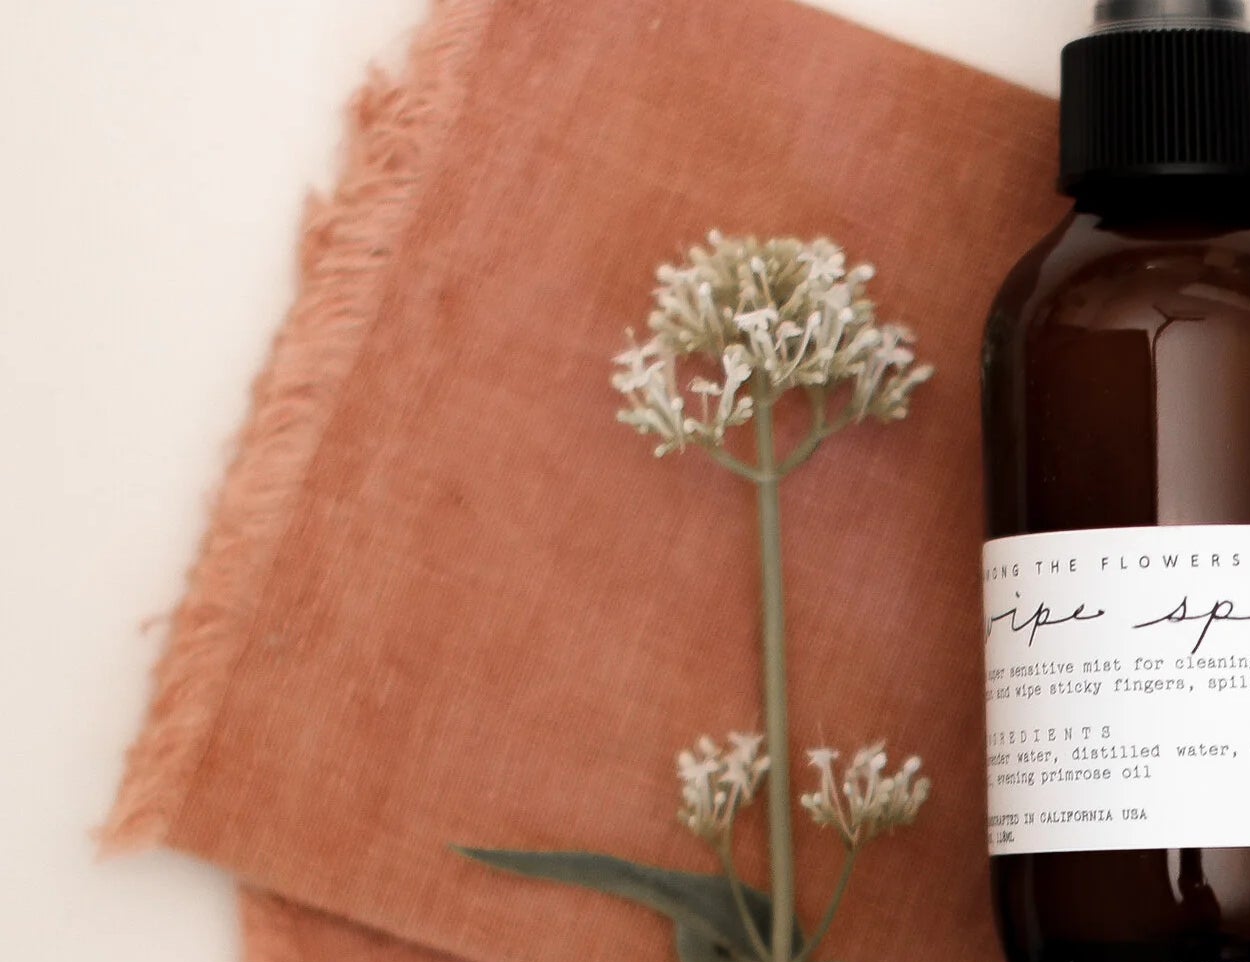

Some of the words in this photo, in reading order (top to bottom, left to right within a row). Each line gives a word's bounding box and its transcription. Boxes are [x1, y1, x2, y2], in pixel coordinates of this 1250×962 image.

[1035, 558, 1076, 574] THE
[1101, 553, 1240, 571] FLOWERS
[1009, 661, 1074, 678] sensitive
[1081, 657, 1122, 674] mist
[1133, 656, 1165, 672] for
[1015, 683, 1041, 699] wipe
[1049, 679, 1102, 695] sticky
[1114, 677, 1193, 694] fingers,
[1016, 748, 1059, 765] water,
[1071, 743, 1160, 760] distilled
[1175, 742, 1237, 759] water,
[1040, 767, 1111, 785] primrose
[1120, 763, 1152, 780] oil
[1038, 808, 1114, 824] CALIFORNIA
[1121, 807, 1148, 821] USA
